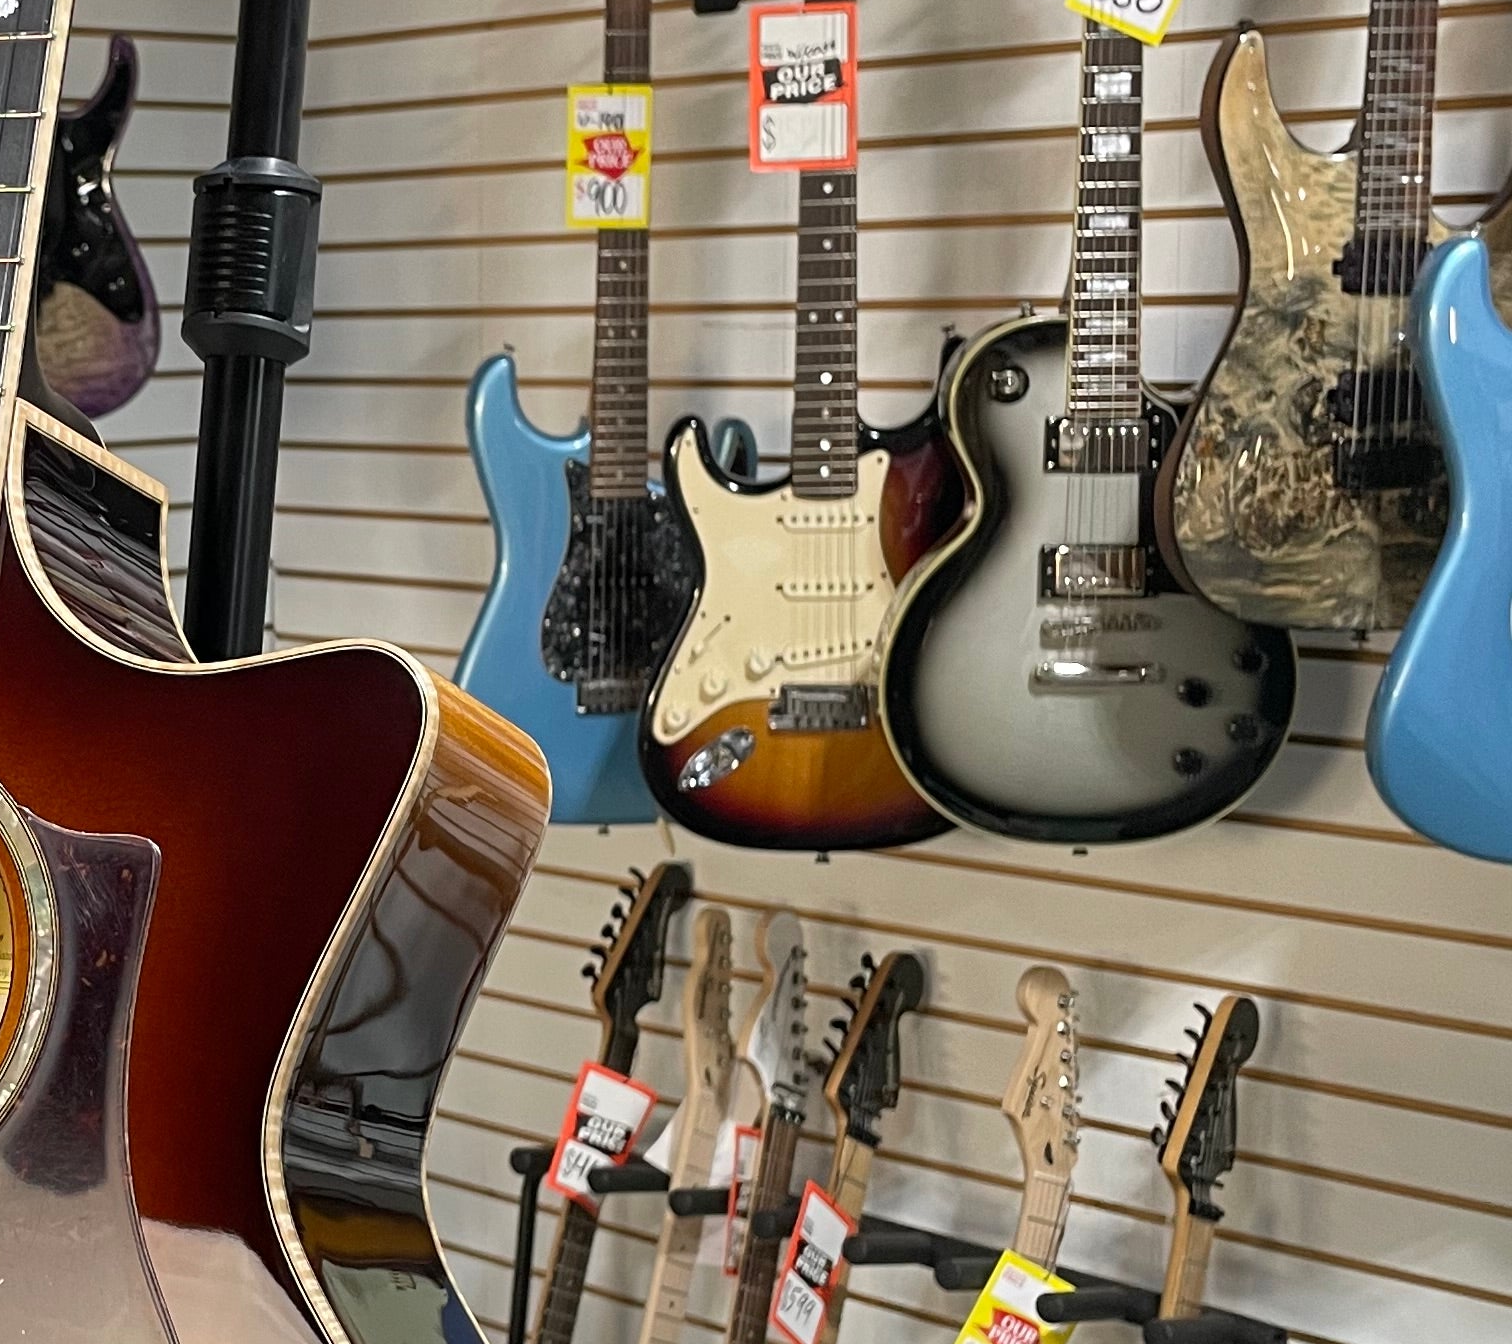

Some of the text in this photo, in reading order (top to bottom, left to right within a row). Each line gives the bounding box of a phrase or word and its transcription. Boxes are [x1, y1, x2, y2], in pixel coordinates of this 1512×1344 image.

[770, 73, 837, 101] PRICE
[776, 63, 825, 84] OUR
[762, 113, 776, 153] $
[577, 1126, 627, 1154] PRICE
[587, 1115, 626, 1137] OUR
[1000, 1314, 1039, 1344] OUR
